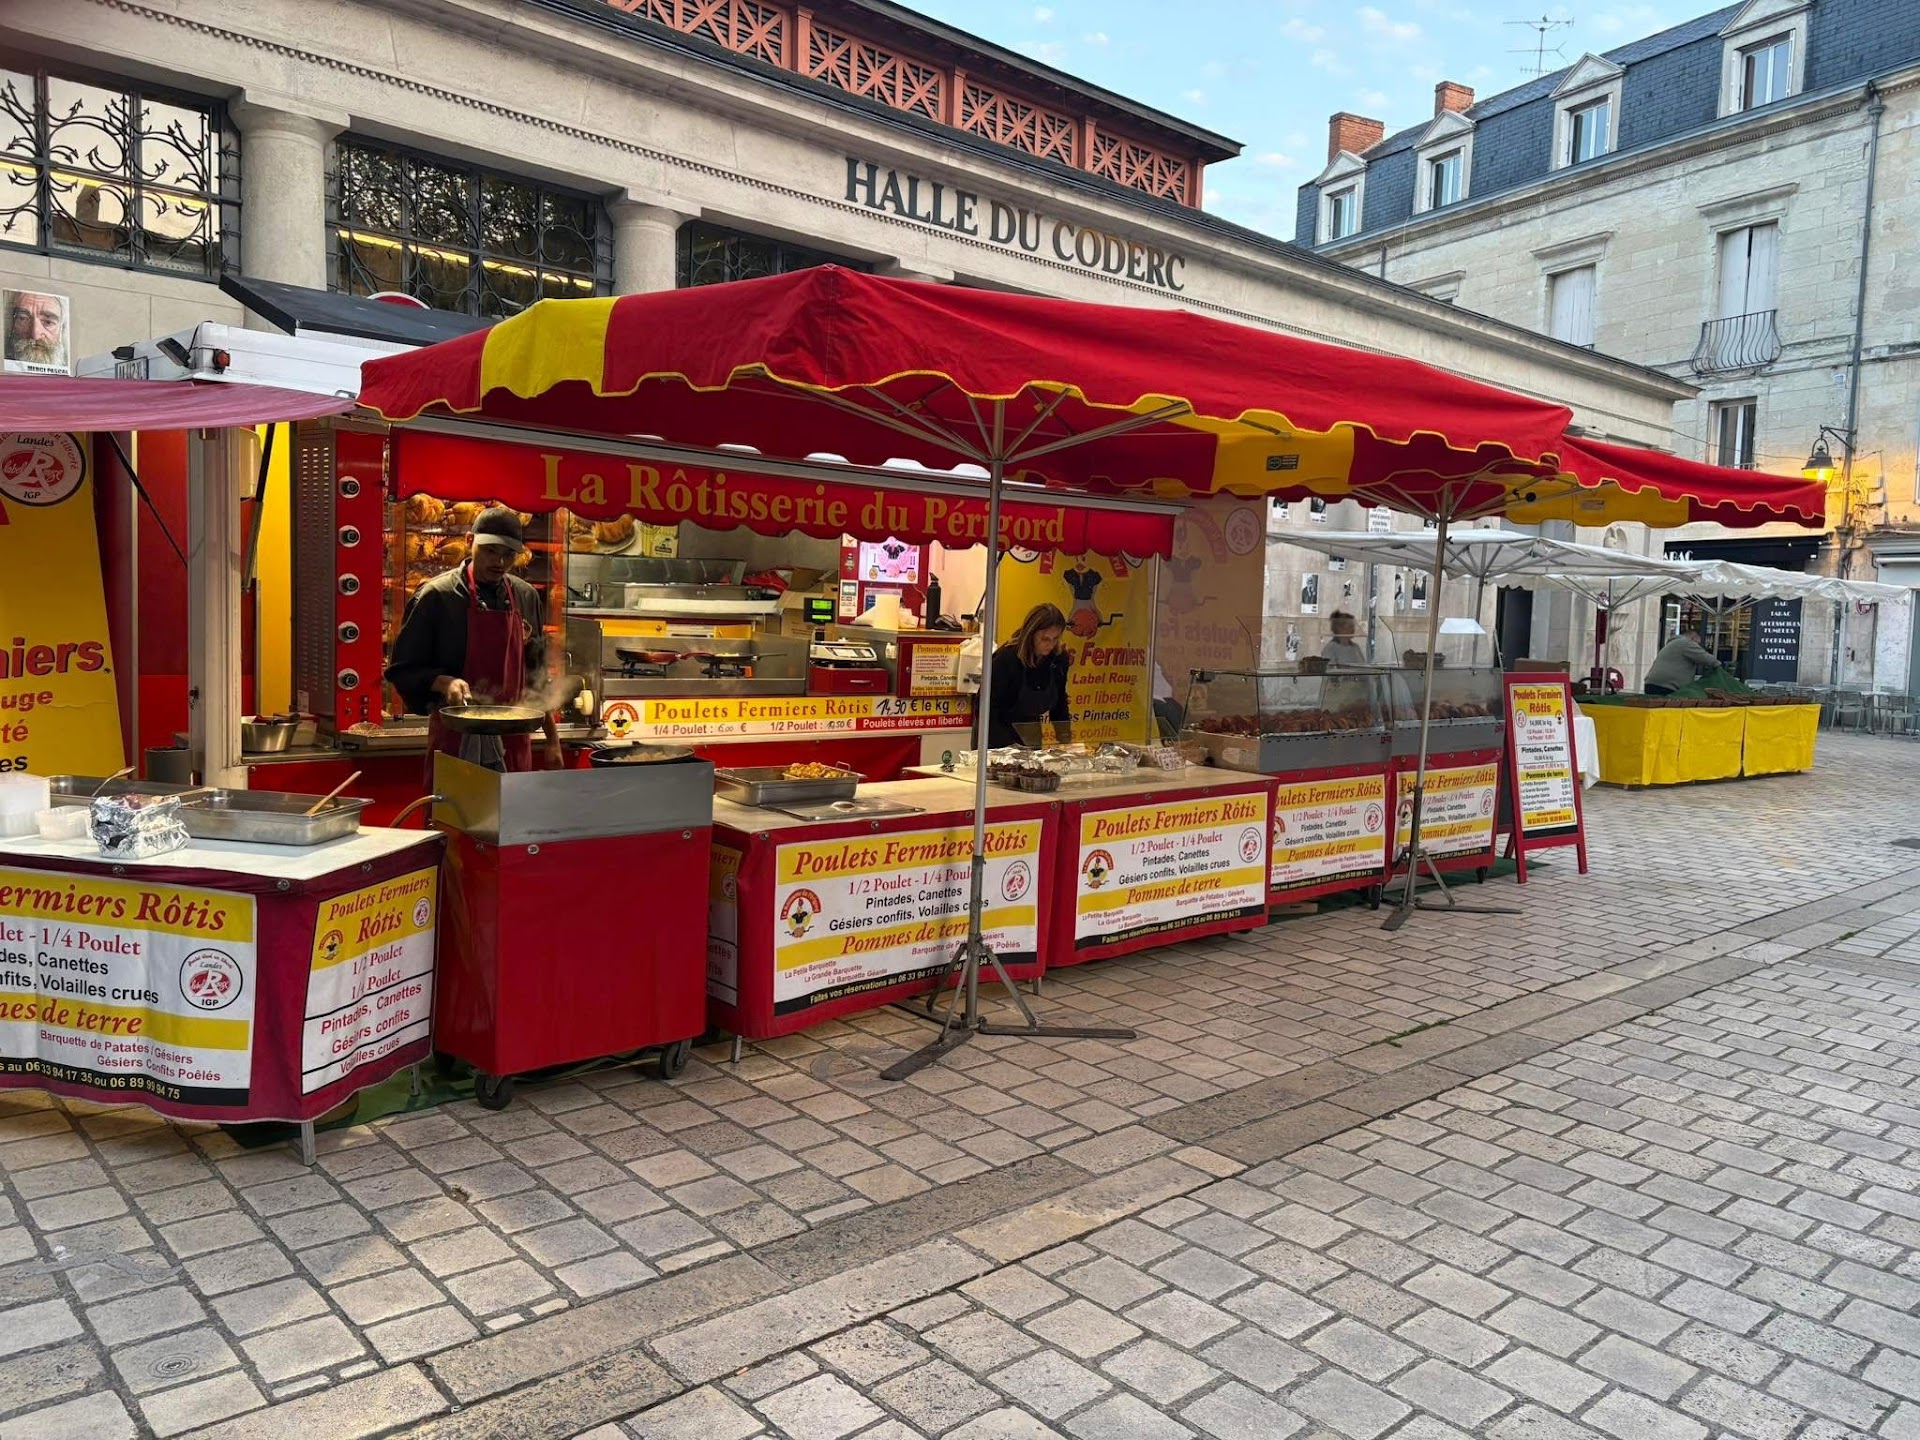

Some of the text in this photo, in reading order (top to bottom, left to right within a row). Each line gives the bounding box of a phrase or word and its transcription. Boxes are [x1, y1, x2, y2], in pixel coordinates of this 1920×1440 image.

[845, 157, 1185, 291] HALLE DU CODERC
[17, 434, 54, 447] Landes
[24, 491, 41, 499] IGP
[541, 454, 1066, 551] La Rôtisserie du Périgord
[1072, 673, 1106, 684] Label
[910, 699, 918, 712] €
[922, 699, 932, 711] le
[936, 698, 949, 714] kg
[1076, 690, 1132, 705] en liberté
[1514, 689, 1562, 700] Poulets Fermiers
[654, 699, 868, 720] Poulets Fermiers Rôtis
[1083, 709, 1130, 721] Pintades
[1529, 702, 1551, 713] Rôtis
[654, 723, 747, 736] 1/4 Poulet €
[771, 718, 852, 731] 1/2 Poulet €
[863, 718, 896, 728] Poulets
[898, 717, 924, 727] élevés
[938, 716, 963, 725] liberté
[1522, 746, 1543, 754] Pintades,
[1437, 774, 1474, 788] Fermiers
[1474, 770, 1495, 782] Rôtis
[1308, 781, 1382, 802] Fermiers Rôtis
[1093, 800, 1256, 838] Poulets Fermiers Rôtis
[792, 830, 1028, 876] Poulets Fermiers Rôtis
[1131, 831, 1222, 856] 1/2 Poulet 1/4 Poulet
[1287, 849, 1322, 862] Pommes
[1324, 842, 1334, 856] de
[1336, 842, 1356, 854] terre
[1143, 848, 1210, 867] Pintades, Canettes
[849, 866, 973, 895] 1/2 Poulet 1/4 Poul
[1119, 858, 1230, 885] Gésiers confits, Volailles crues
[328, 876, 431, 922] Poulets Fermiers
[866, 886, 962, 910] Pintades, Canettes
[1126, 876, 1221, 905] Pommes de terre
[134, 892, 227, 931] Rôtis
[829, 903, 964, 931] Gésiers confits, Volailles
[356, 909, 404, 943] Rôtis
[841, 920, 970, 955] Pommes de terr
[42, 928, 73, 948] 1/4
[78, 931, 141, 956] Poulet
[912, 943, 945, 956] Barquette
[38, 952, 109, 976] Canettes
[352, 944, 404, 976] 1/2 Poulet
[808, 960, 837, 973] Barquette
[351, 968, 401, 1000] 1/4 Poulet
[811, 970, 832, 982] Grande
[832, 964, 862, 978] Barquette
[836, 972, 866, 984] Barquette
[41, 974, 107, 998] Volailles
[112, 985, 160, 1004] crues
[810, 993, 828, 1004] Faites
[830, 989, 843, 998] vos
[844, 979, 888, 995] réservations
[888, 977, 898, 985] au
[898, 974, 907, 982] 06
[908, 972, 916, 980] 33
[927, 968, 934, 978] 17
[202, 998, 219, 1006] IGP
[321, 982, 422, 1036] Pintades, Canettes
[42, 999, 70, 1026] de
[77, 1008, 143, 1035] terre
[332, 1008, 410, 1054] Gésiers confits
[41, 1029, 193, 1064] Barquette de Patates Gésiers
[378, 1037, 400, 1056] crues
[8, 1063, 22, 1072] au
[26, 1061, 41, 1072] 06
[41, 1064, 52, 1075] 33
[52, 1067, 64, 1078] 94
[66, 1070, 77, 1081] 17
[81, 1072, 92, 1083] 35
[94, 1077, 107, 1087] ou
[110, 1077, 126, 1088] 06
[130, 1077, 144, 1088] 89
[156, 1084, 166, 1096] 94
[168, 1087, 180, 1100] 75
[97, 1055, 222, 1082] Gésiers Confits Poêlés
